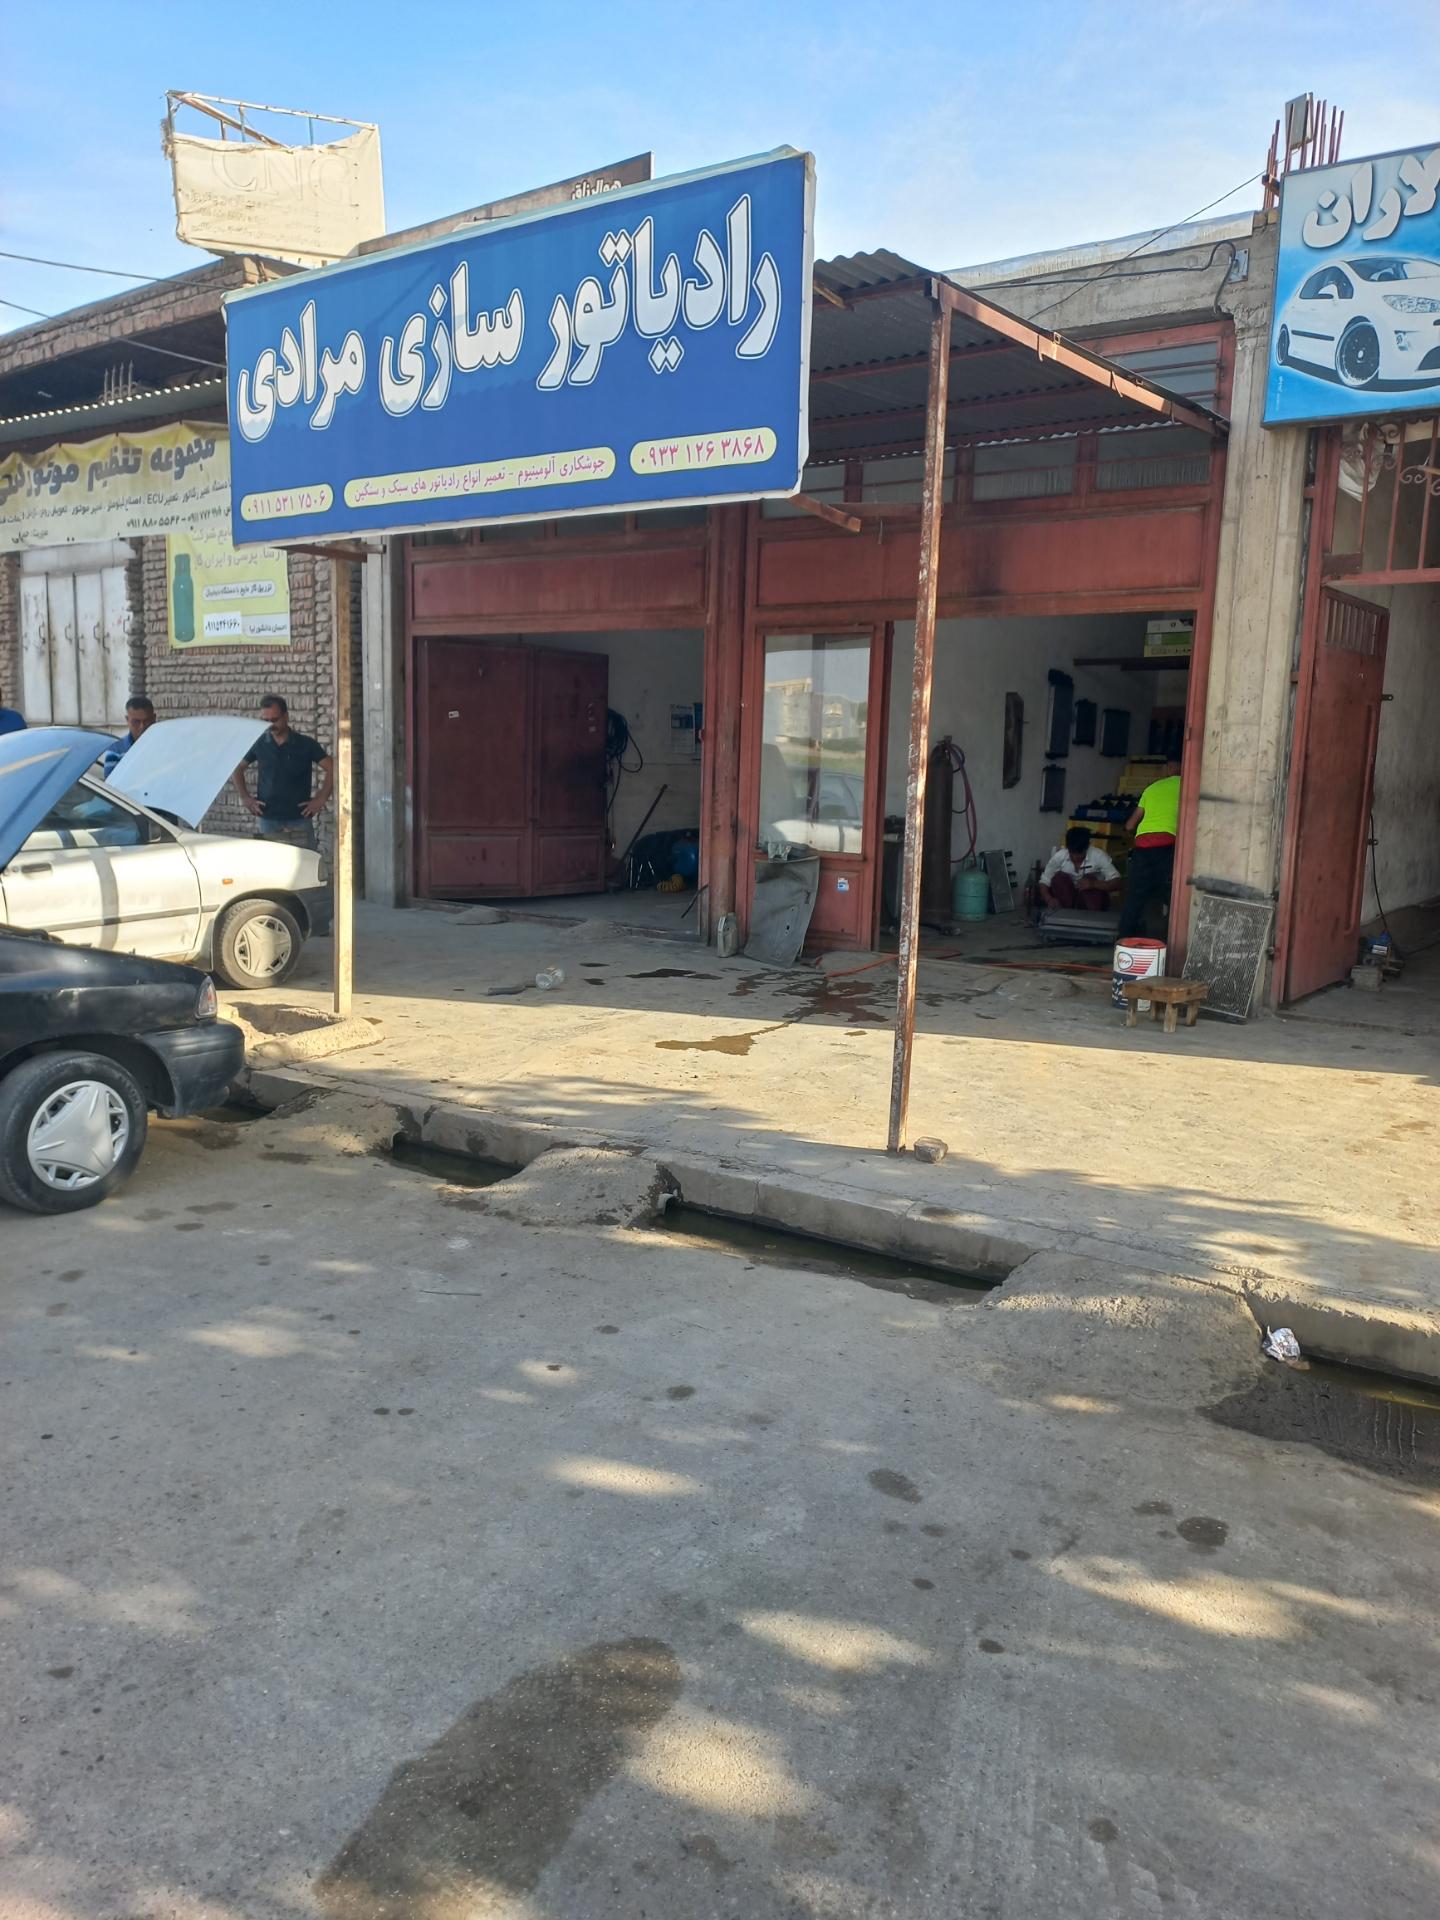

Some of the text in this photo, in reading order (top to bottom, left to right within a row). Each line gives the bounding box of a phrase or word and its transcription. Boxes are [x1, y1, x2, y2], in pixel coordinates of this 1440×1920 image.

[238, 193, 782, 443] رادیاتور سازی مرادی
[151, 438, 216, 481] مجموعه
[641, 434, 765, 467] ۰۹۳۳ ۱۲۶ ۳۸۶۸
[88, 446, 143, 492] تنظیم
[517, 456, 556, 485] آلومینیوم
[559, 455, 606, 477] جوشکاری
[27, 462, 79, 497] موتور
[388, 478, 407, 494] سبک
[411, 477, 427, 495] های
[430, 473, 460, 493] رادیاتور
[463, 469, 481, 491] انواع
[484, 468, 506, 487] تعمیر
[147, 493, 163, 504] ECU
[247, 498, 271, 514] ۰۹۱۱
[275, 495, 293, 512] ۵۳۱
[299, 490, 326, 509] ۷۵۰۶
[355, 483, 379, 502] سنگین
